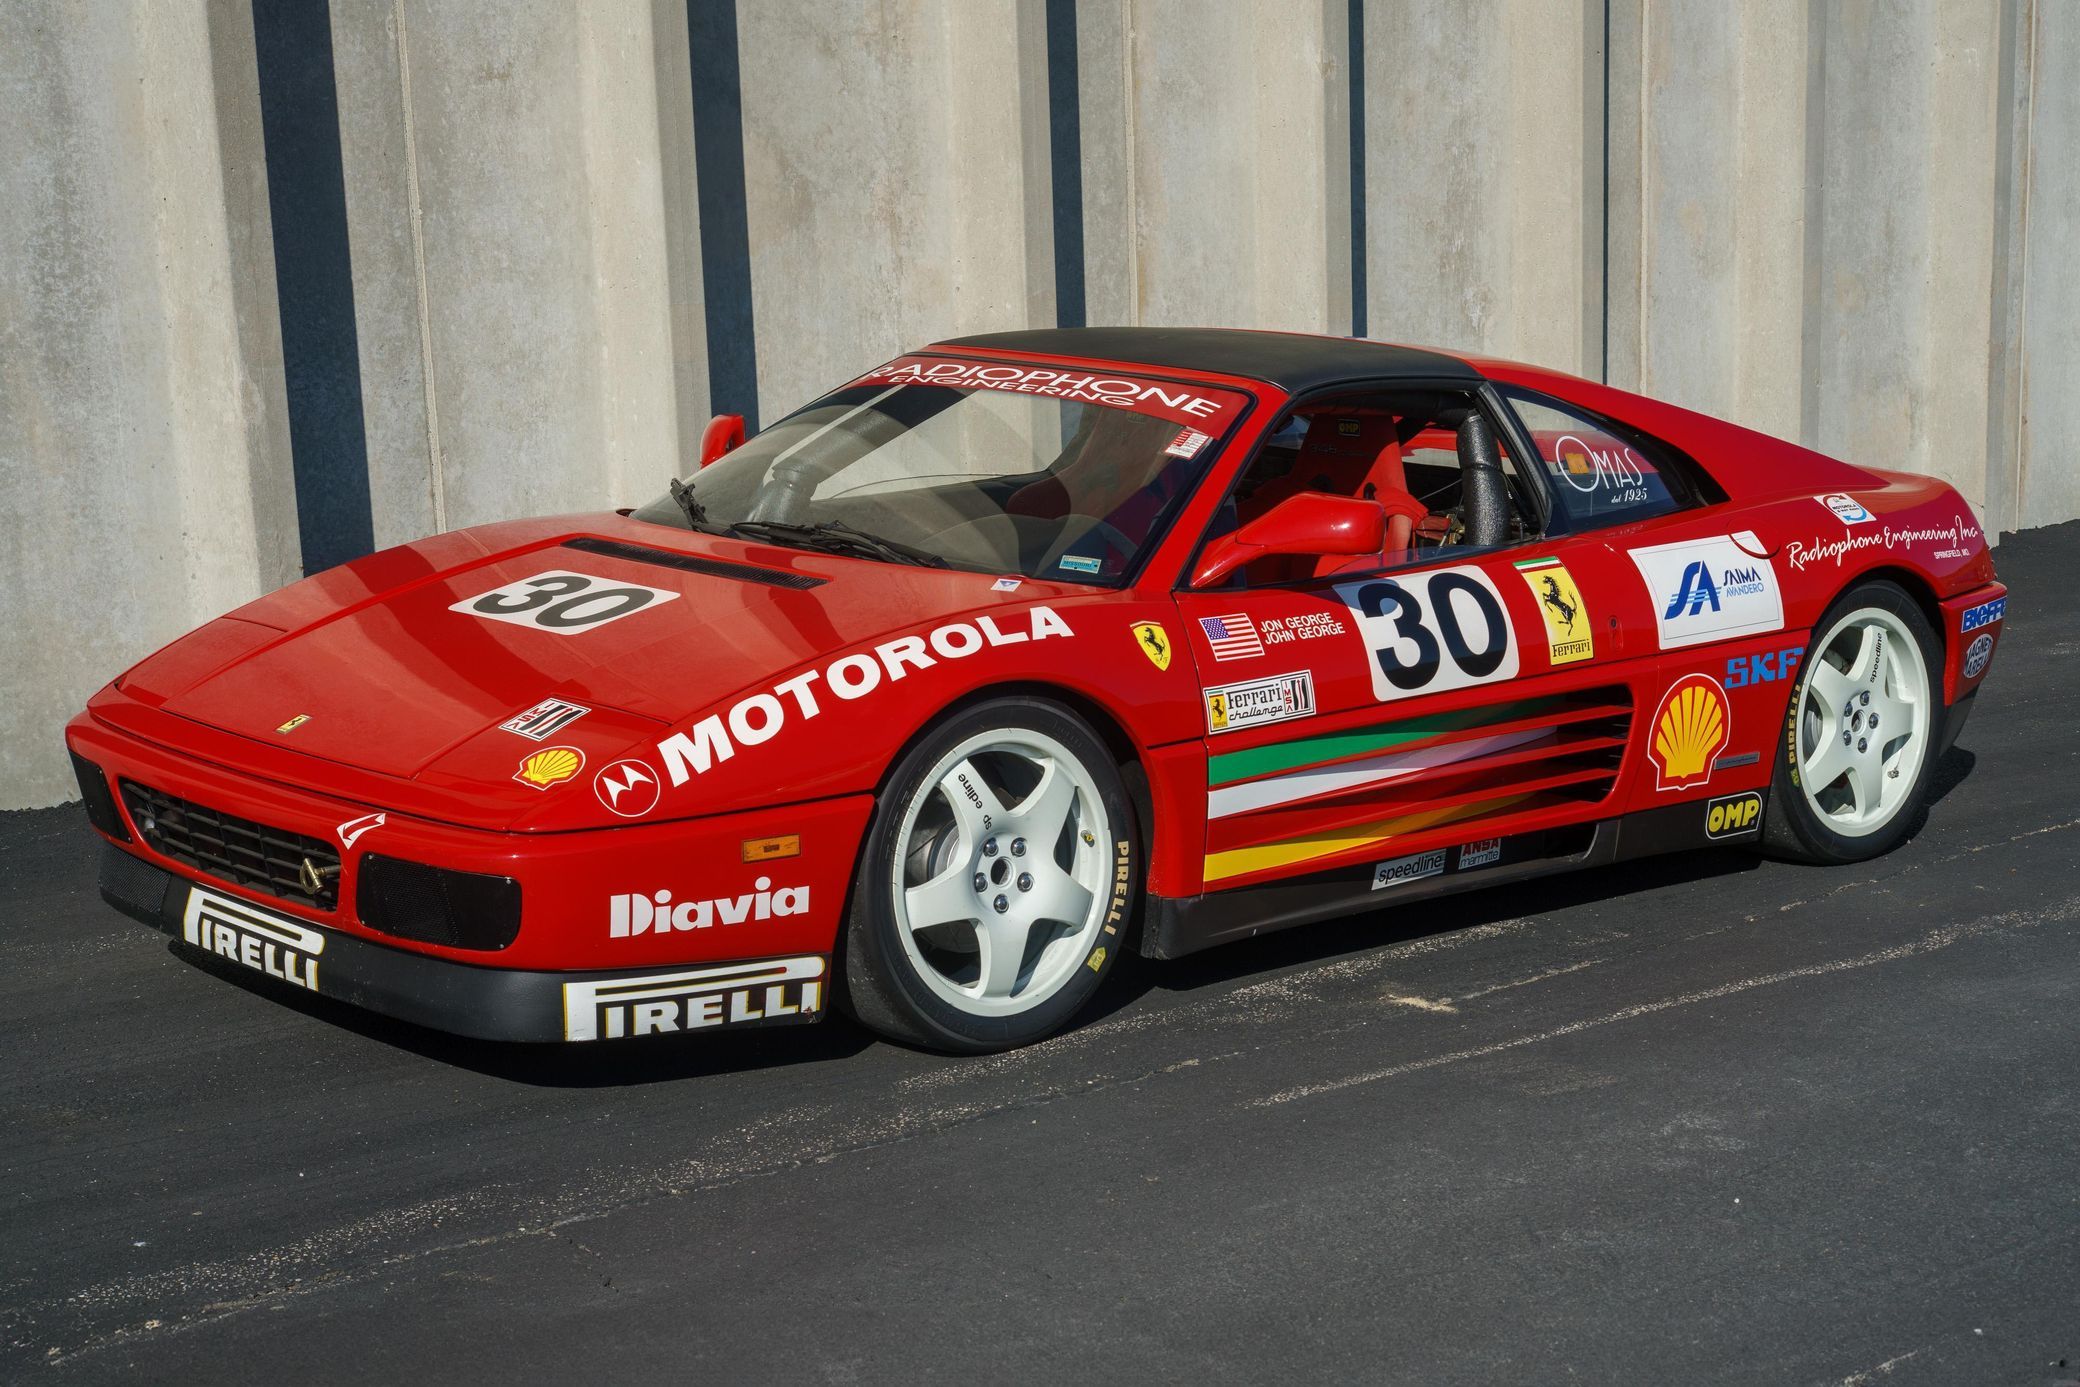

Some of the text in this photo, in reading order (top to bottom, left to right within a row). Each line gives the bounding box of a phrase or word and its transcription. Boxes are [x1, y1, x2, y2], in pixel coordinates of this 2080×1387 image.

[866, 363, 1222, 417] RADIOPHONE
[887, 375, 1135, 406] ENGINEERING
[1556, 435, 1643, 492] OMAS
[1624, 488, 1648, 503] 1925
[1786, 528, 1882, 571] Radiophone
[1884, 523, 1957, 549] Engineering
[1723, 566, 1762, 587] SAIMA
[1726, 583, 1764, 597] AVANDERO
[472, 575, 655, 627] 30
[1260, 612, 1334, 633] JON GEORGE
[1265, 622, 1346, 645] JOHN GEORGE
[1357, 572, 1508, 690] 30
[1551, 638, 1591, 658] Ferrari
[1870, 632, 1882, 683] speedline
[1724, 647, 1804, 689] SKF
[656, 605, 1075, 788] MOTOROLA
[1226, 683, 1283, 710] Ferrari
[1229, 704, 1284, 721] challenge
[1787, 684, 1801, 764] PIRELLI
[1708, 799, 1760, 832] OMP
[1460, 850, 1499, 867] marmitte
[1462, 840, 1500, 857] ANSA
[1378, 853, 1443, 885] speedline
[1104, 840, 1130, 936] PIRELLI
[609, 876, 810, 938] Diavia
[183, 884, 325, 991] PIRELLI
[563, 955, 826, 1042] PIRELLI
